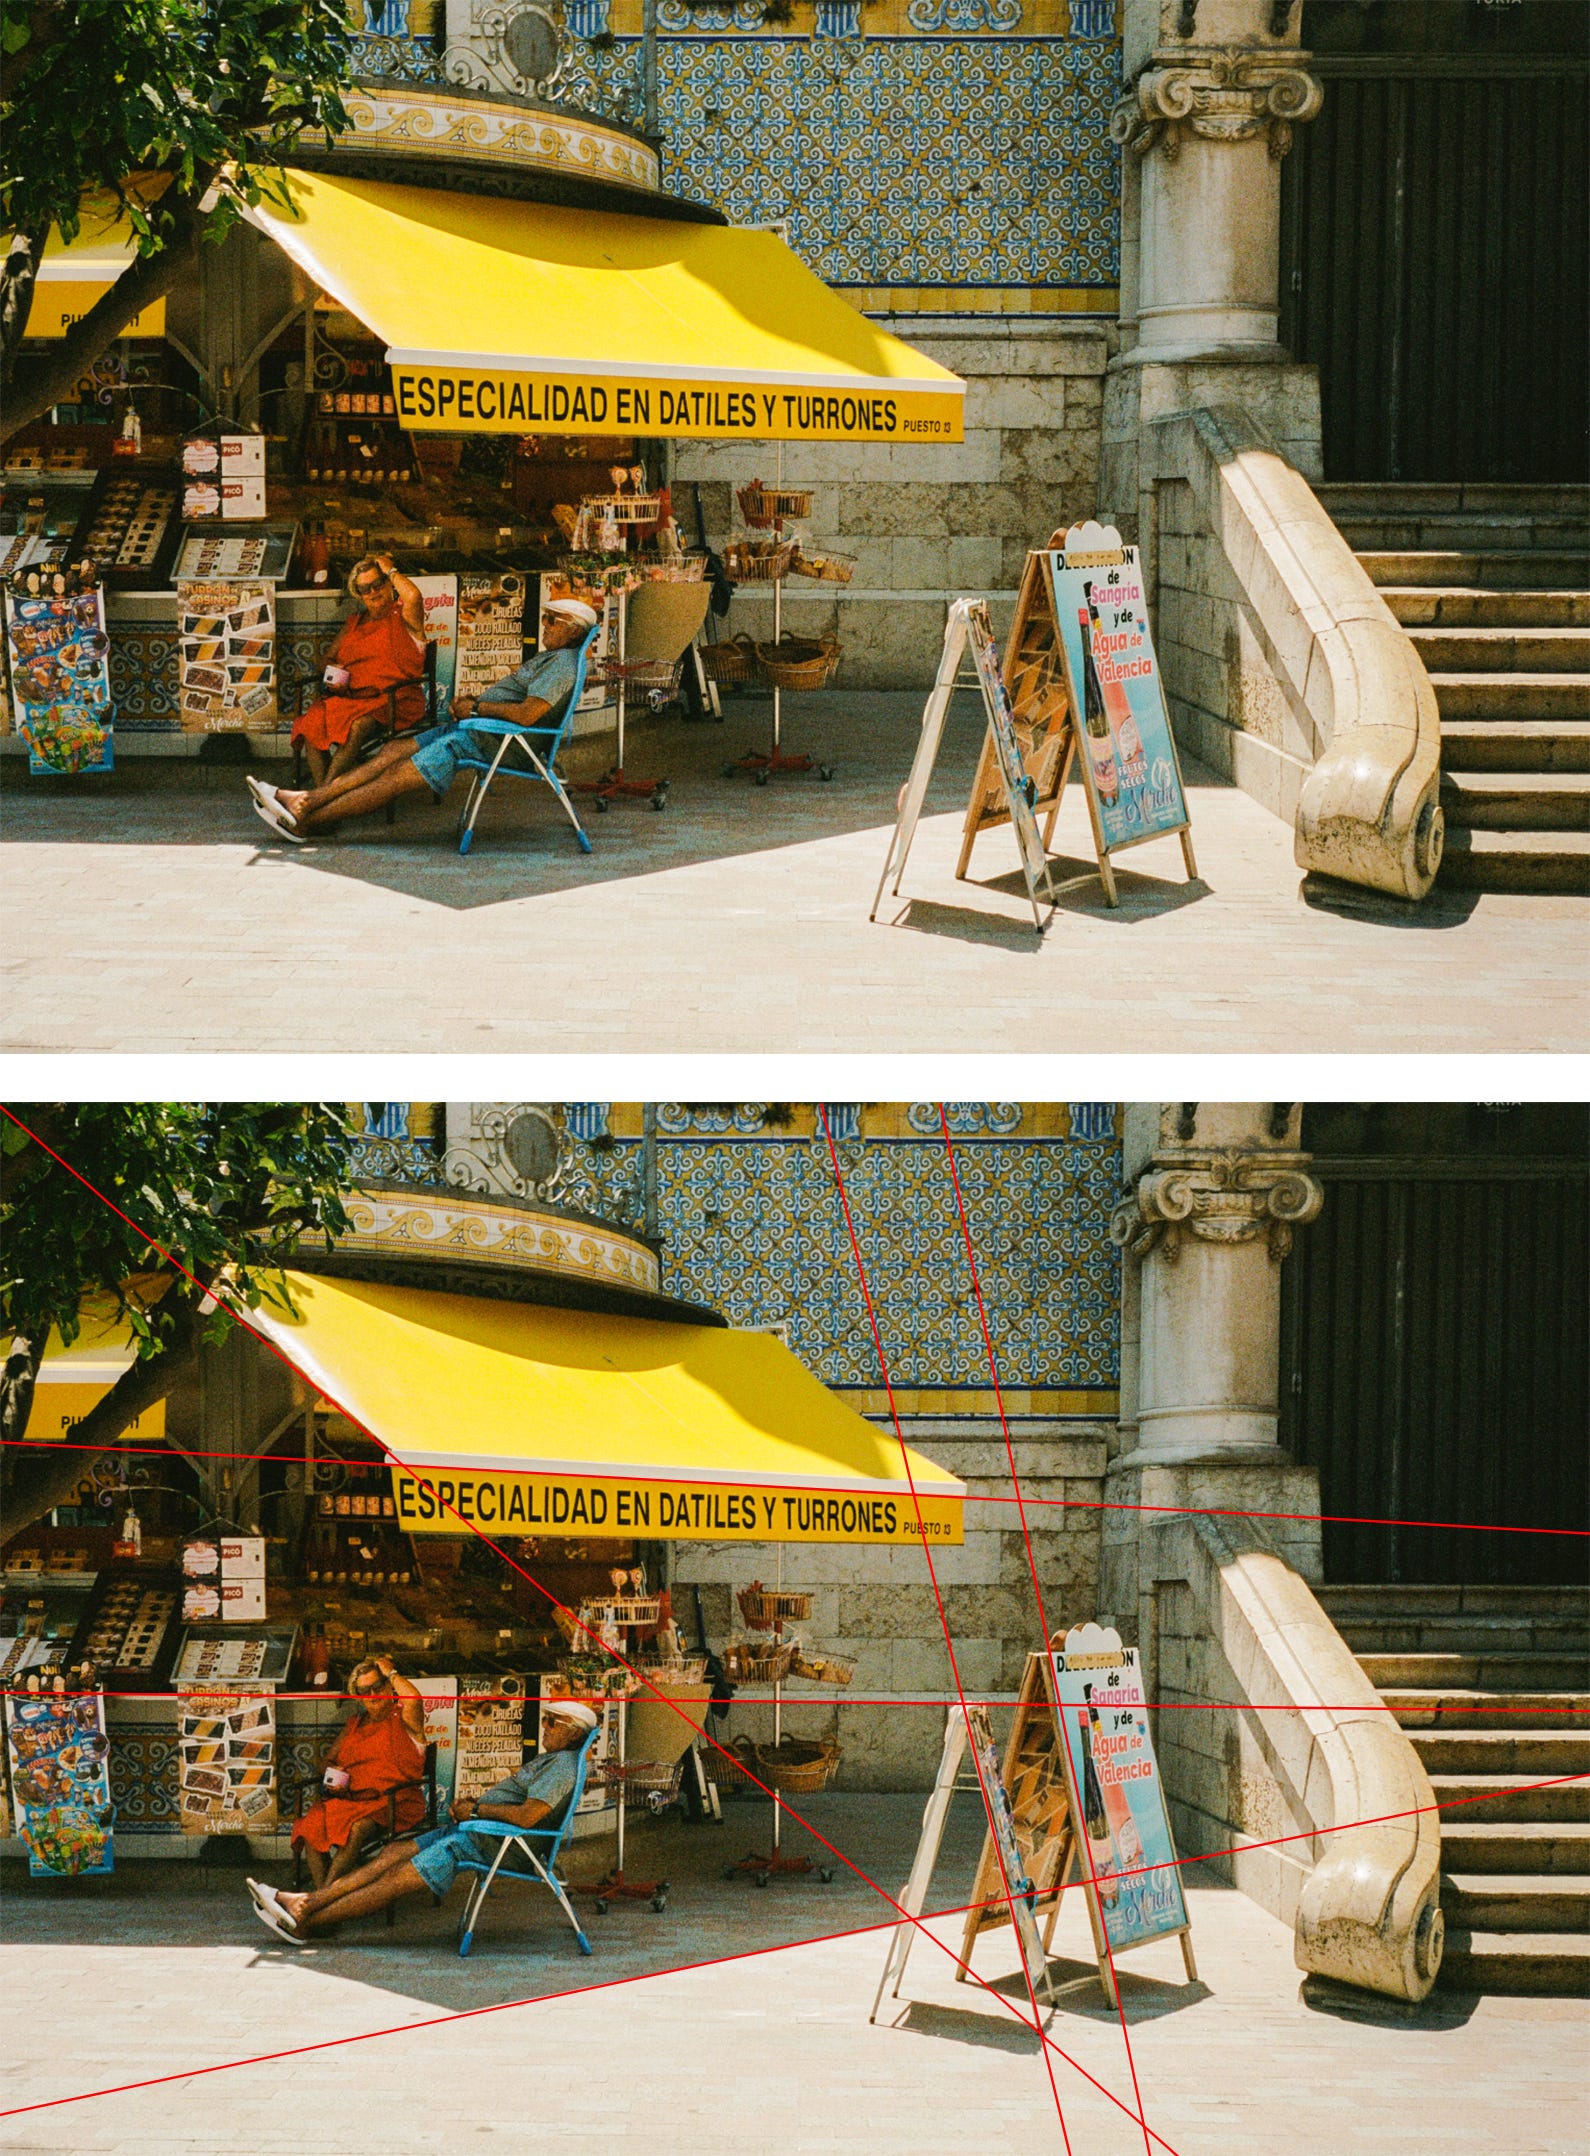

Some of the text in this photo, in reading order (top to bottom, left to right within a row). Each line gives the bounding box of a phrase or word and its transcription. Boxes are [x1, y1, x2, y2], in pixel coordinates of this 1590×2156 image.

[399, 376, 897, 432] ESPECIALIDAD EN DATILES Y TURRONES
[903, 419, 951, 433] PUESTO 13
[1107, 570, 1120, 585] de
[1113, 608, 1133, 628] y de
[1092, 631, 1142, 659] Agua de
[1096, 656, 1152, 682] Valencia
[1119, 761, 1148, 776] FRUTOS
[1121, 774, 1146, 789] SECOS
[399, 1478, 897, 1534] ESPECIALIDAD EN DATILES Y TURRONES
[903, 1521, 941, 1535] PUESTO
[1107, 1672, 1120, 1687] de
[1113, 1710, 1133, 1730] y de
[1092, 1733, 1142, 1761] Agua de
[1096, 1758, 1152, 1784] Valencia
[1121, 1876, 1146, 1891] SECOS
